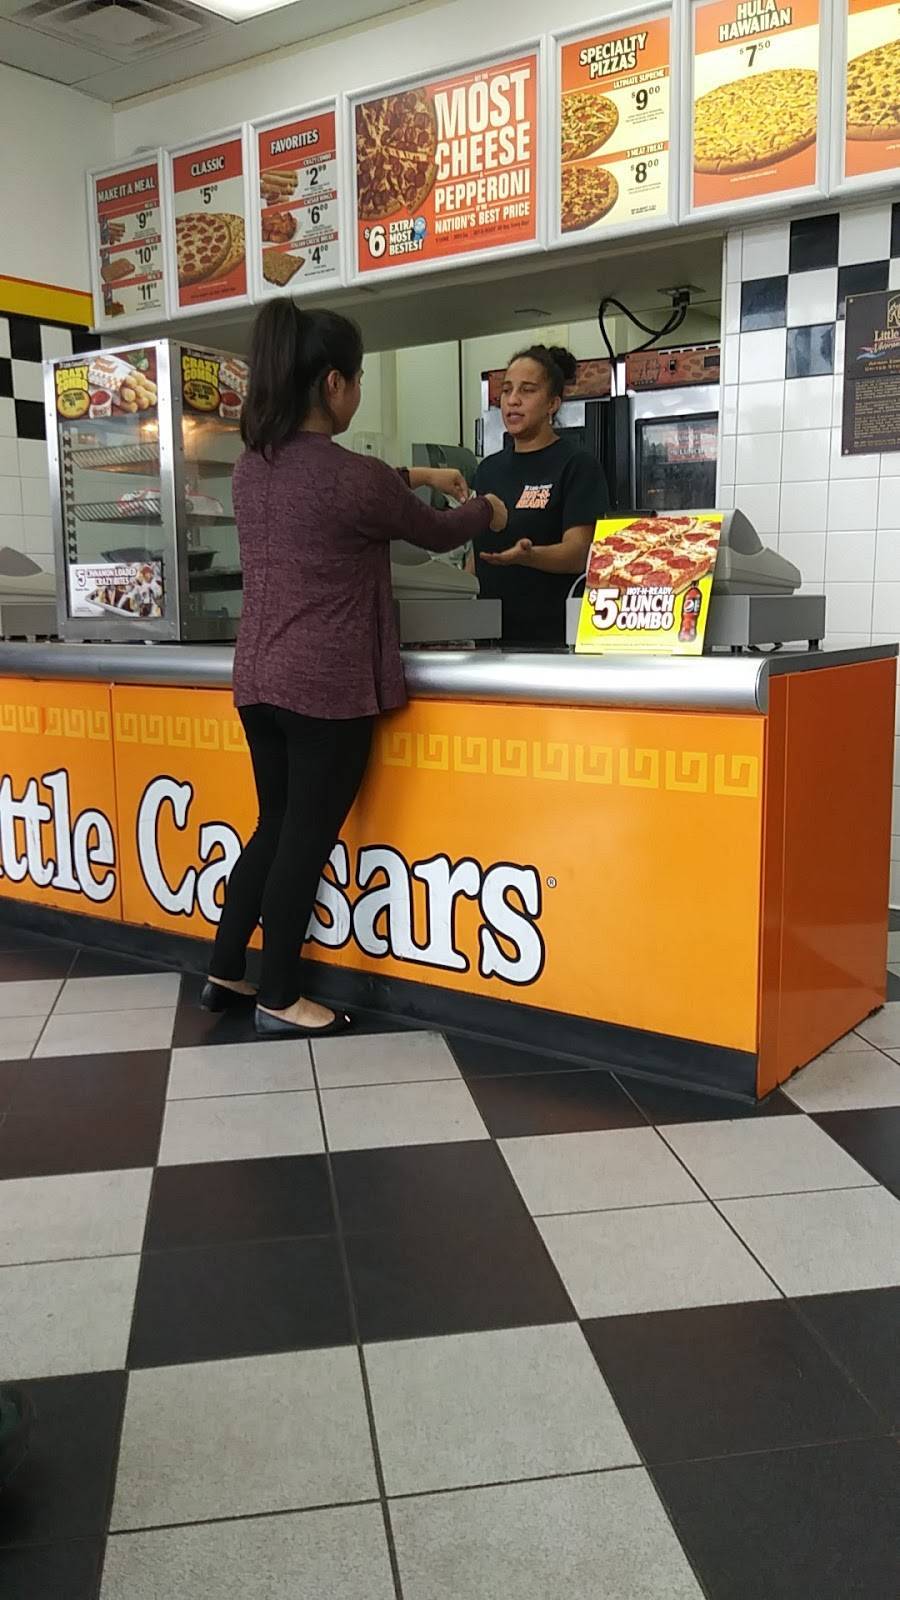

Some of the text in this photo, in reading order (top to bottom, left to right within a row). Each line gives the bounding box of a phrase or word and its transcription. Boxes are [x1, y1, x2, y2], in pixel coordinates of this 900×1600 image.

[737, 0, 777, 20] HULA
[718, 7, 792, 42] HAWAIIAN
[579, 32, 648, 66] SPECIALTY
[590, 52, 637, 79] PIZZAS
[434, 68, 531, 141] MOST
[270, 129, 320, 155] FAVORITES
[435, 121, 530, 181] CHEESE
[191, 156, 225, 177] CLASSIC
[97, 177, 155, 203] MAKE IT A MEAL
[435, 168, 530, 214] PEPPERONI
[389, 218, 414, 234] EXTRA
[434, 214, 476, 235] NATION'S
[478, 207, 500, 225] BEST
[503, 201, 530, 220] PRICE
[364, 225, 386, 258] $6
[389, 229, 412, 245] MOST
[389, 239, 424, 256] BESTEST
[182, 355, 219, 377] CRAZY
[589, 588, 620, 630] $5
[622, 594, 675, 613] LUNCH
[616, 611, 675, 631] COMBO
[0, 768, 546, 986] ttle Casars
